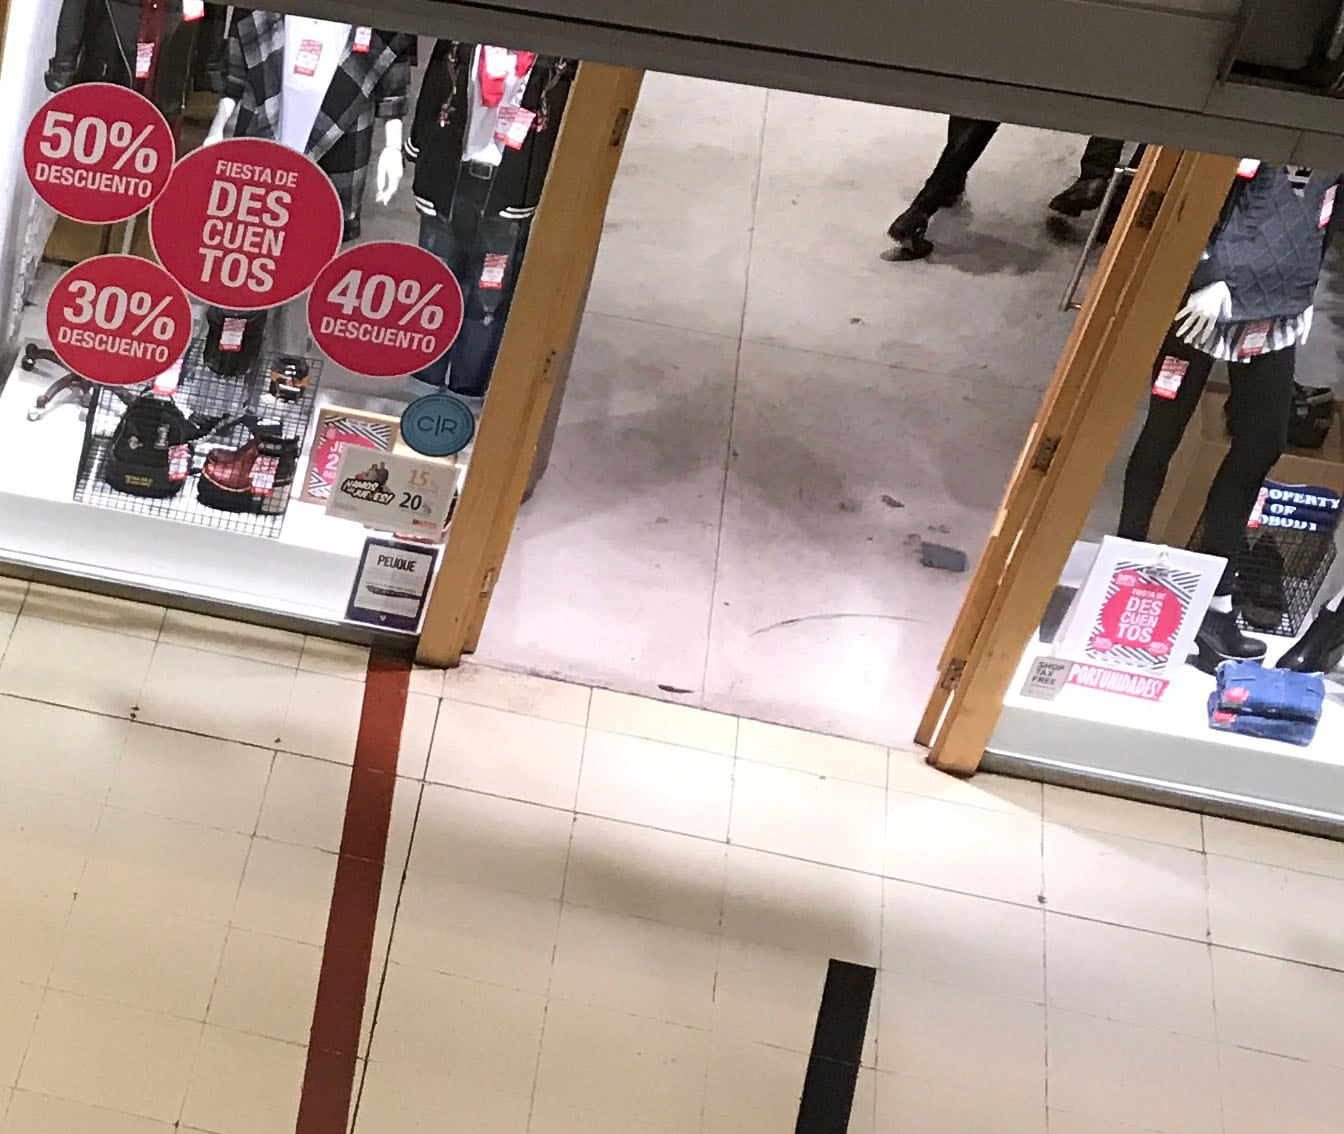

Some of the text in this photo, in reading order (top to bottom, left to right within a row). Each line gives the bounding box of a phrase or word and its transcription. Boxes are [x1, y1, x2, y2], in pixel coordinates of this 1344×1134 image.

[39, 110, 159, 174] 50%
[34, 162, 153, 199] DESCUENTO
[215, 159, 299, 188] FIESTA DE
[206, 179, 292, 228] DES
[202, 218, 286, 257] CUEN
[198, 246, 277, 293] TOS
[63, 279, 176, 341] 30%
[326, 268, 445, 330] 40%
[57, 325, 170, 363] DESCUENTO
[319, 316, 437, 354] DESCUENTO
[1269, 488, 1341, 510] OPERTY
[1269, 503, 1297, 516] OF
[1119, 610, 1159, 628] CUEN
[1125, 596, 1163, 617] DES
[1116, 622, 1154, 644] TOS
[1031, 676, 1057, 686] FREE
[1036, 668, 1053, 678] TAX
[1038, 660, 1065, 672] SHOP
[1069, 663, 1163, 699] PORTUNIDADES!
